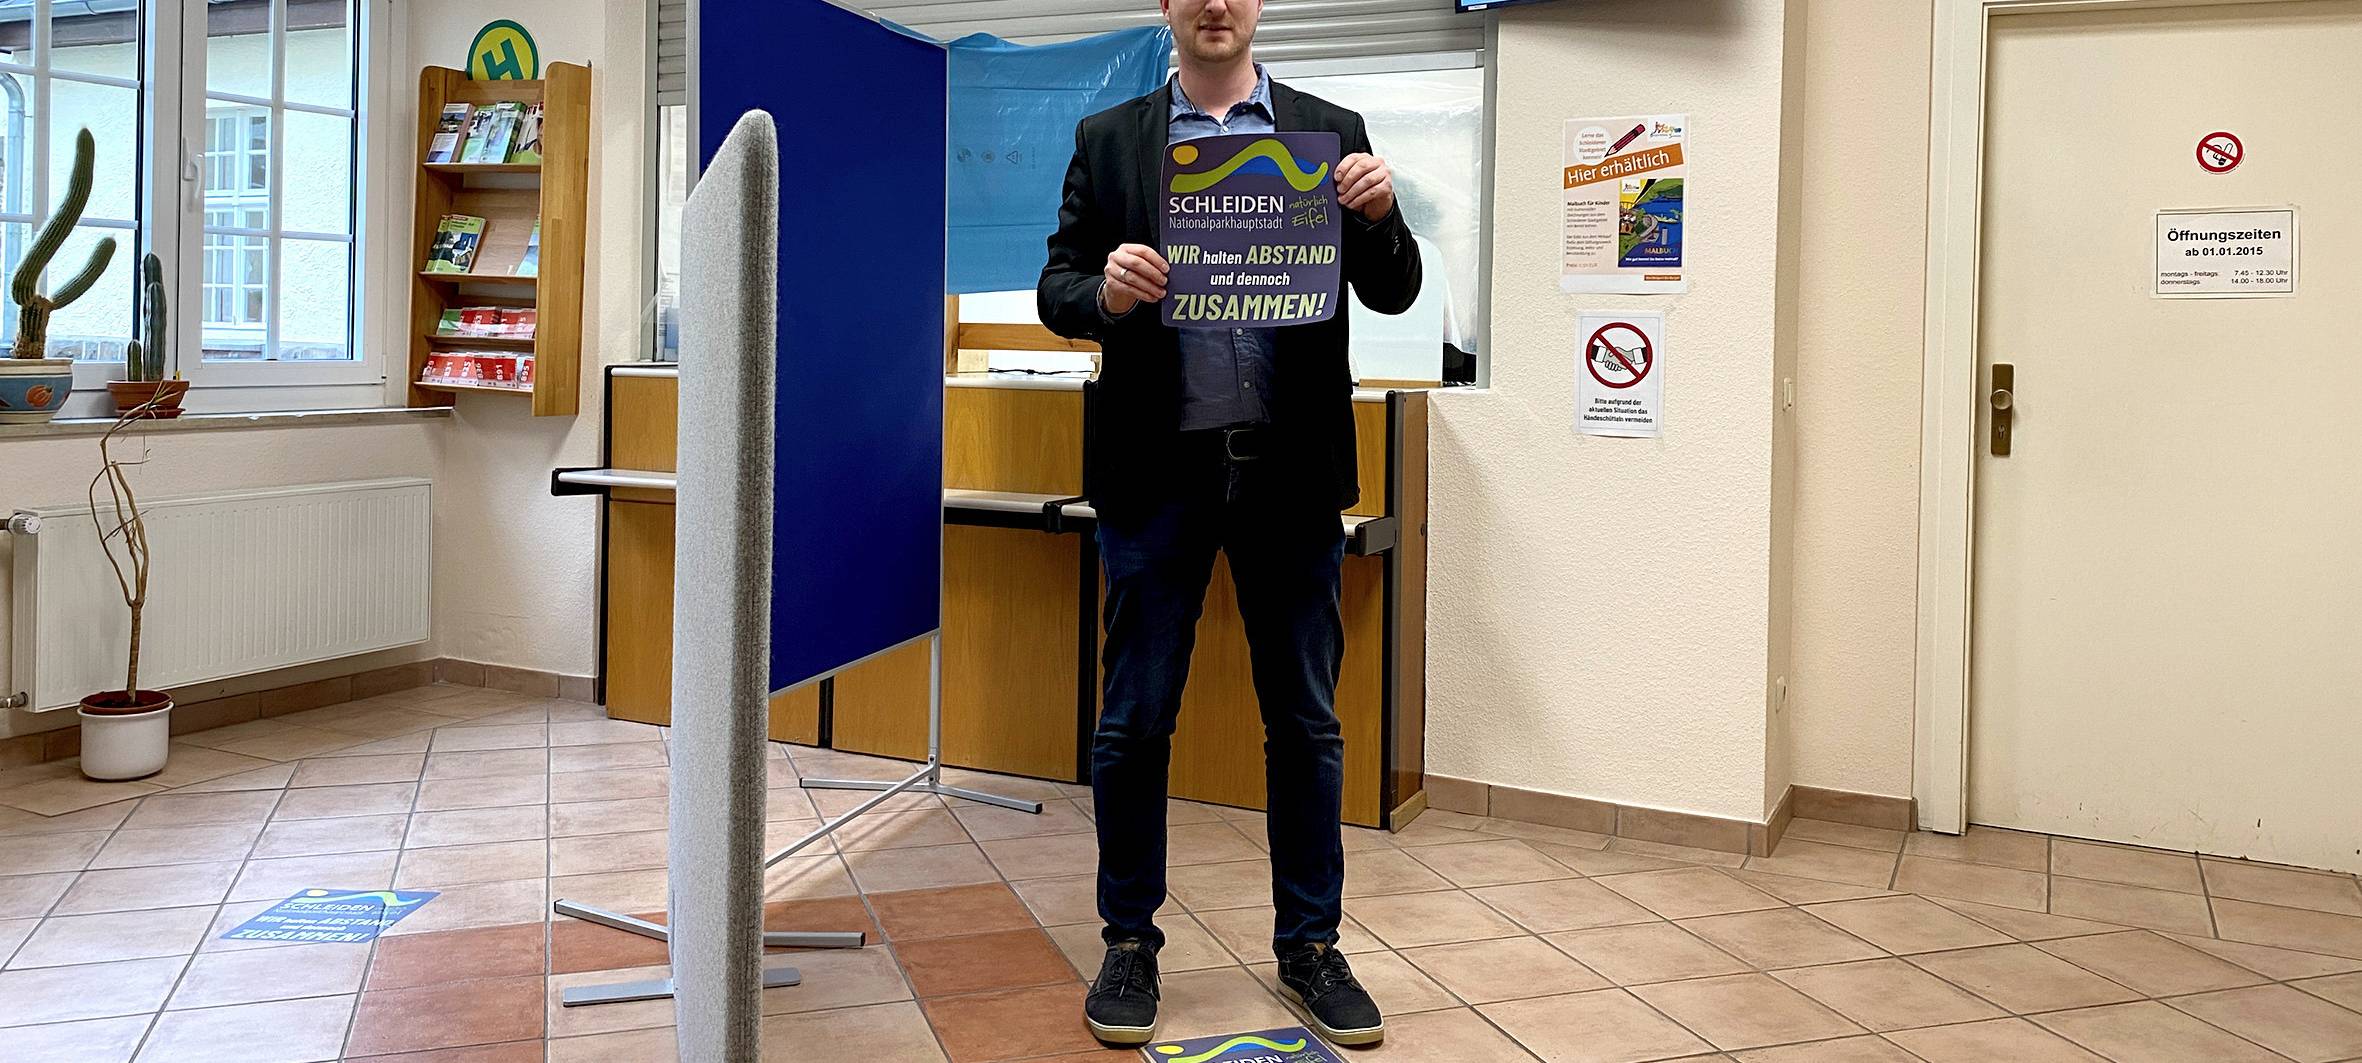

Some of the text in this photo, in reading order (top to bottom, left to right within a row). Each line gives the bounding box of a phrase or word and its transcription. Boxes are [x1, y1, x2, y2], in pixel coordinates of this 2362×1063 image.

[482, 38, 524, 80] H
[1567, 150, 1670, 185] Hier erhältlich
[1169, 195, 1284, 214] SCHLEIDEN
[1289, 195, 1328, 209] natürlich
[1169, 216, 1283, 231] Nationalparkhauptstadt
[1291, 207, 1329, 229] Eifel
[2167, 228, 2281, 243] Öffnungszeiten
[1167, 245, 1336, 265] WIR halten ABSTAND
[2185, 247, 2263, 257] ab 01.01.2015
[1210, 272, 1290, 286] und dennoch
[1172, 293, 1327, 320] ZUSAMMEN!
[1608, 398, 1631, 406] aufgrund
[1584, 414, 1624, 422] Händeschütteln
[280, 903, 375, 911] SCHLEIDEN
[231, 929, 370, 942] ZUSAMMEN!
